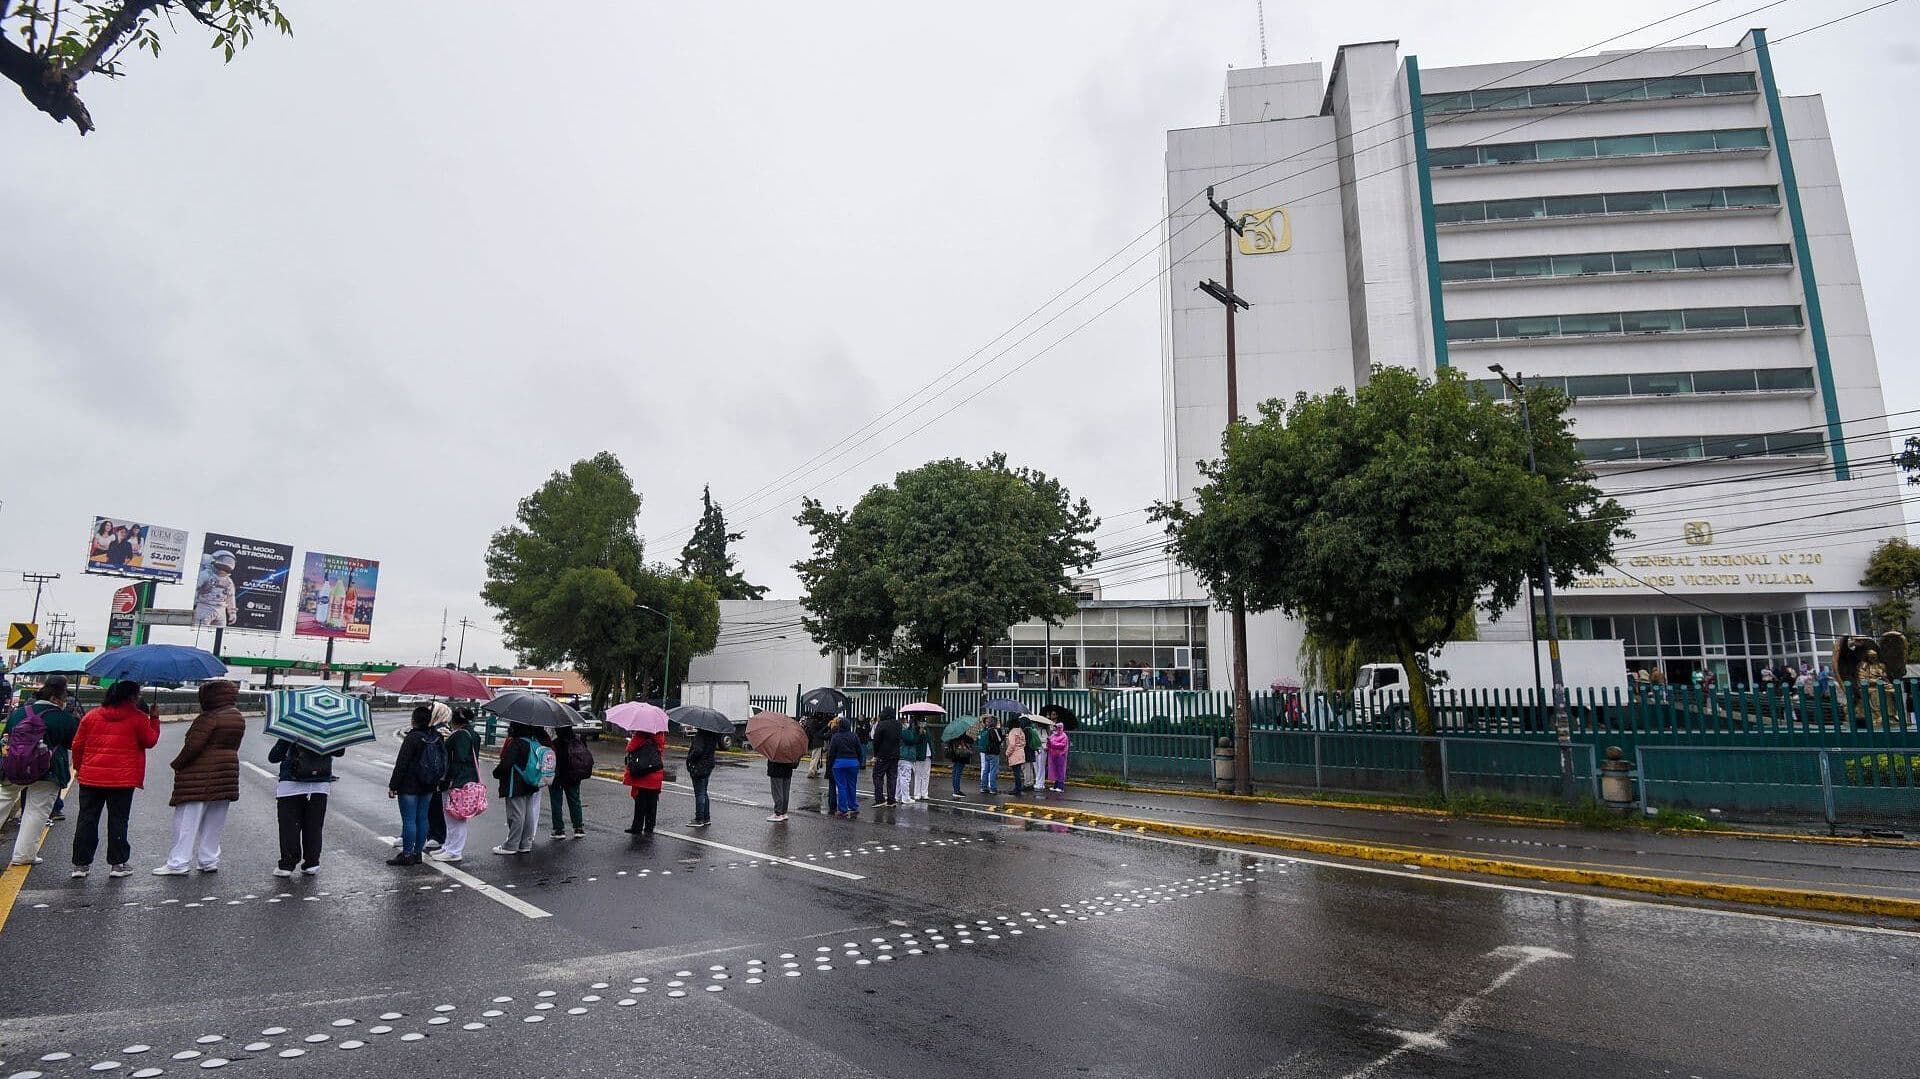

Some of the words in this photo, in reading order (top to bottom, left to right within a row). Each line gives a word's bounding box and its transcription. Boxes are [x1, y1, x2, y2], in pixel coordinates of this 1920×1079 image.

[214, 540, 241, 549] ACTIVA
[253, 546, 275, 554] MODO
[236, 549, 284, 561] ASTRONAUTA
[1628, 555, 1695, 567] GENERAL
[1699, 554, 1771, 566] REGIONAL
[1799, 553, 1822, 565] 220
[1680, 574, 1741, 586] VICENTE
[1744, 573, 1814, 585] VILLADA
